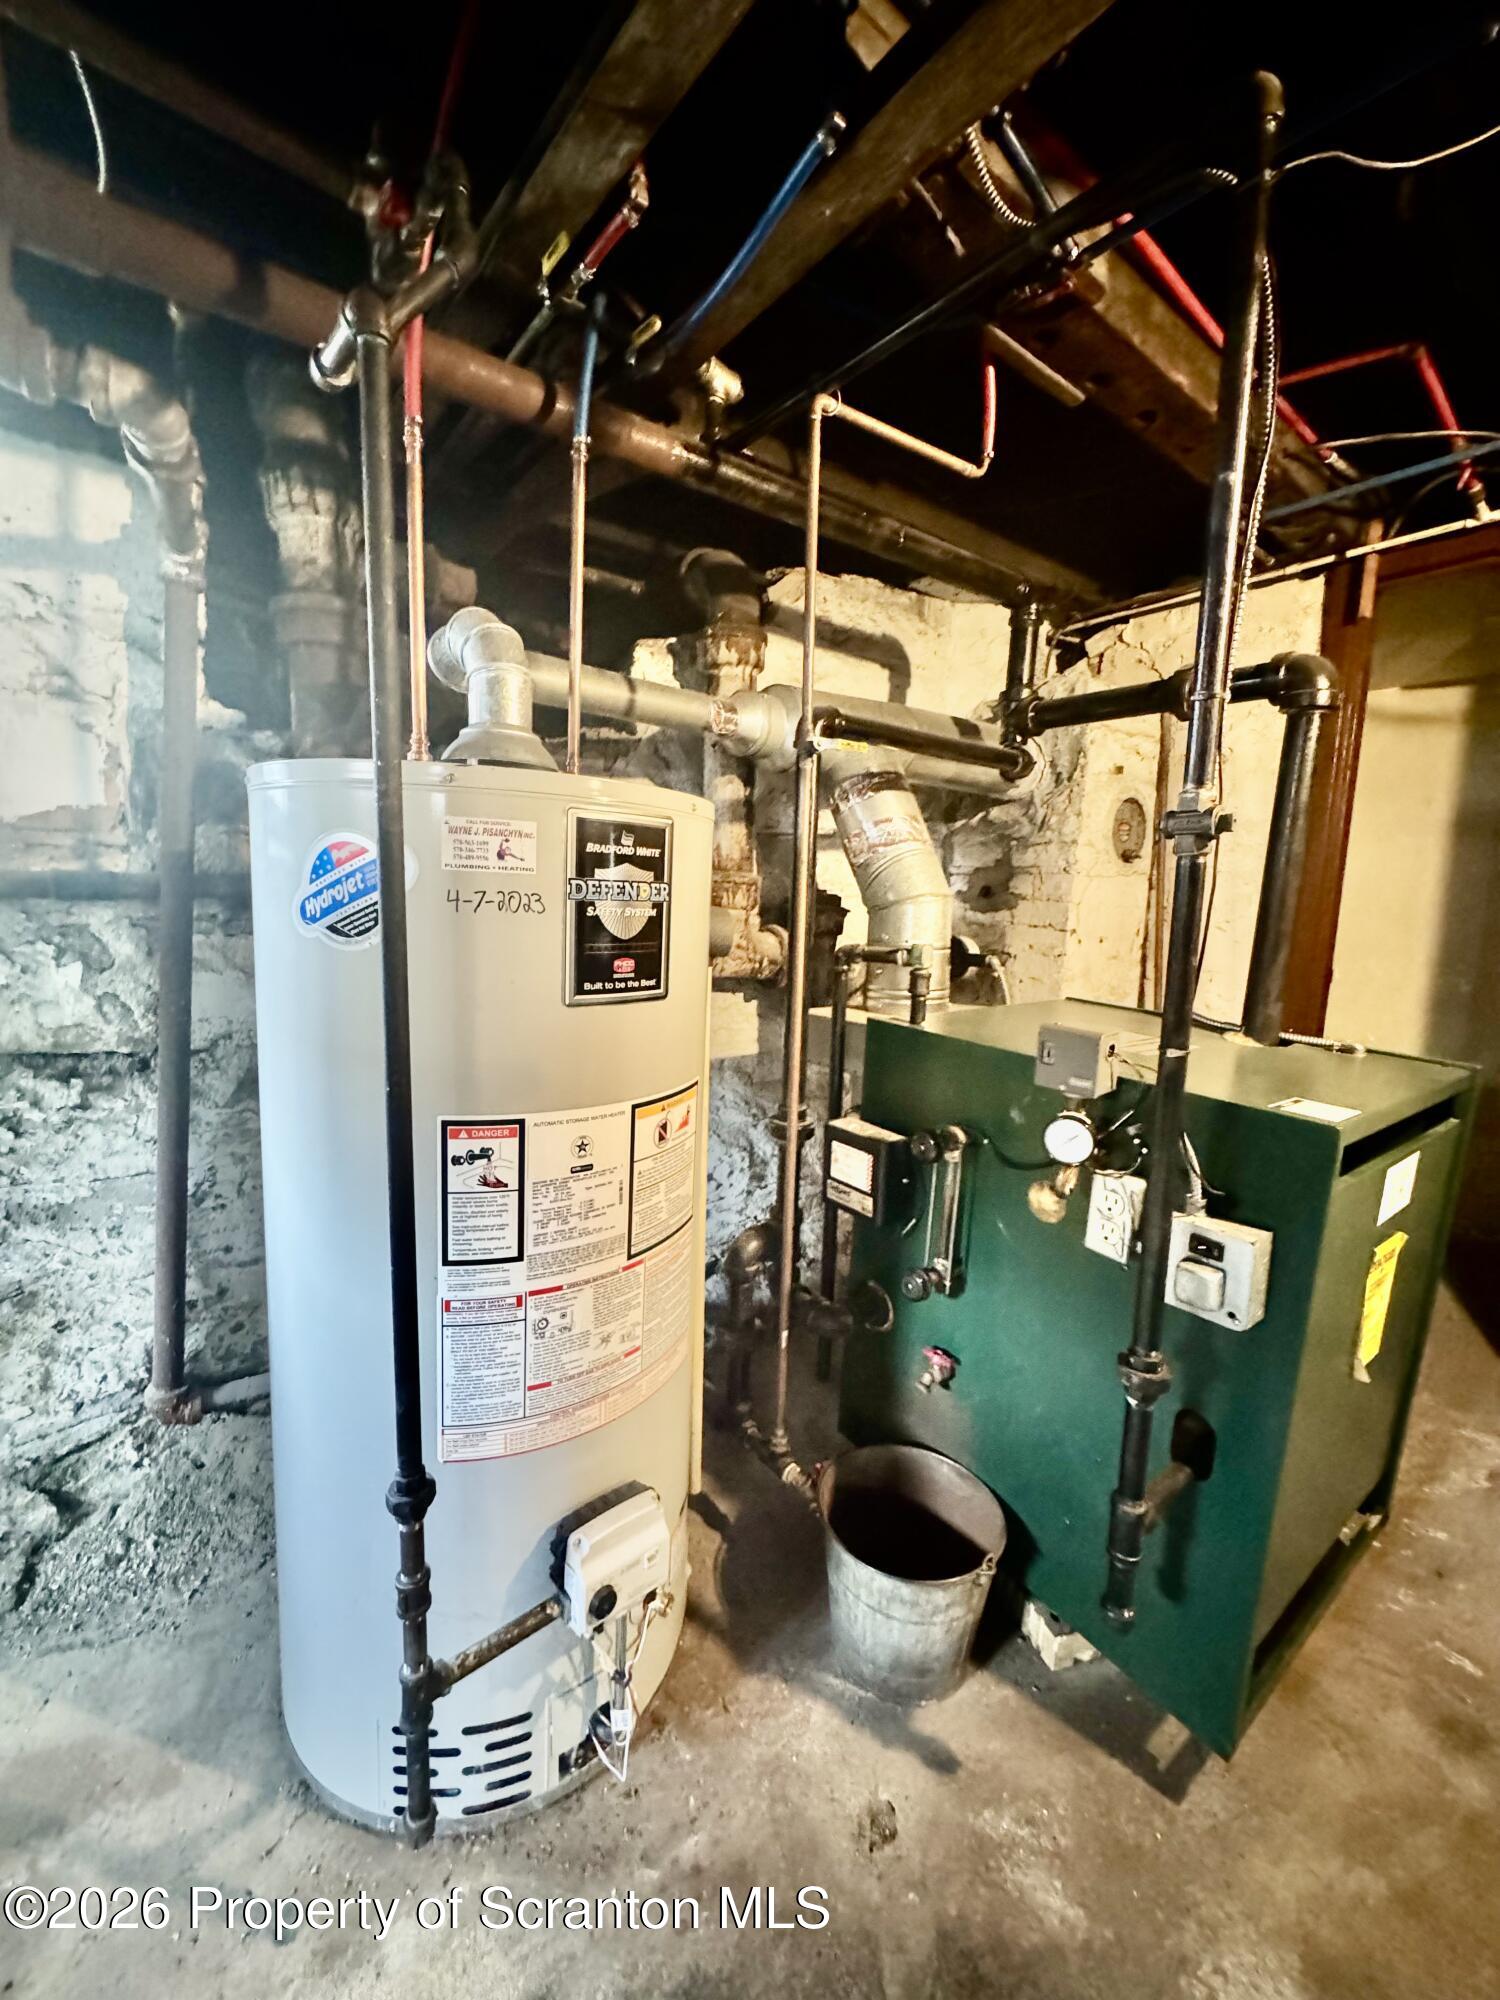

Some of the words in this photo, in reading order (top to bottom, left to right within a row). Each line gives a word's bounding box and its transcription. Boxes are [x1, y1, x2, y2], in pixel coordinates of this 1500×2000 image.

[448, 825, 472, 835] WAYNE
[586, 842, 634, 855] BRADFORD
[636, 847, 661, 858] WHITE
[305, 872, 365, 918] Hydrojet
[569, 879, 669, 901] DEFENDER
[446, 889, 546, 914] 4-7-2023
[586, 906, 622, 916] SAFETY
[624, 907, 657, 917] SYSTEM
[584, 981, 603, 991] Built
[615, 981, 625, 989] be
[627, 980, 639, 988] the
[640, 979, 657, 987] Best
[471, 1129, 510, 1138] DANGER
